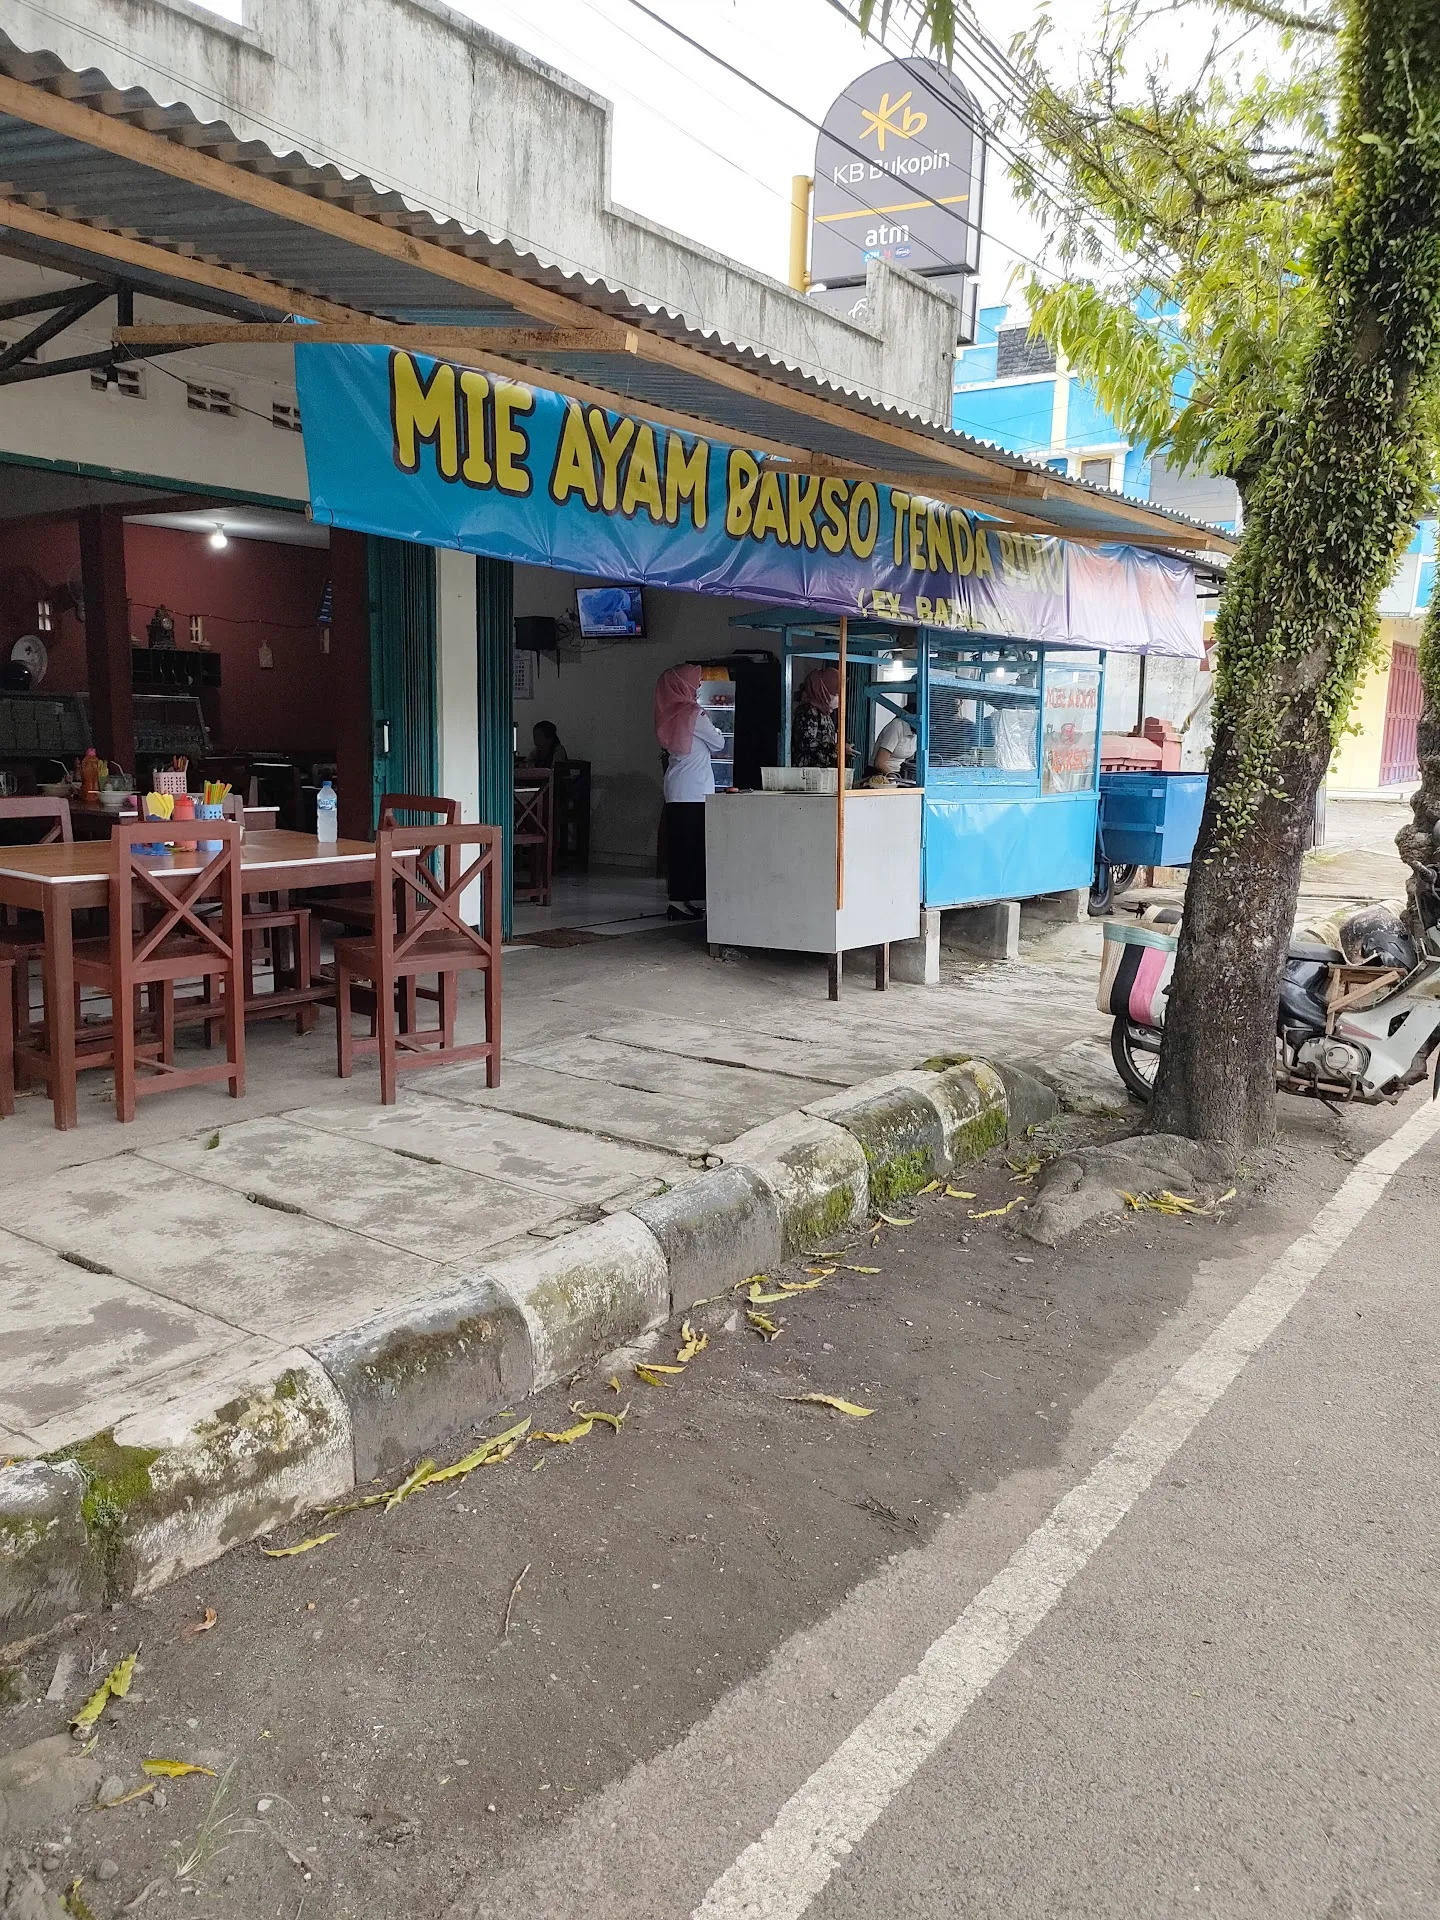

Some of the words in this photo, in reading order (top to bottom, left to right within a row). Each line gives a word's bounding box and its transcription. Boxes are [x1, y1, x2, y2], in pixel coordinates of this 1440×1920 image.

[833, 161, 864, 186] KB
[869, 149, 950, 180] Bukopin
[865, 223, 910, 247] atm
[389, 351, 536, 496] MIE
[549, 400, 712, 531] AYAM
[725, 447, 880, 561] BAKSO
[889, 488, 997, 581] TENDA
